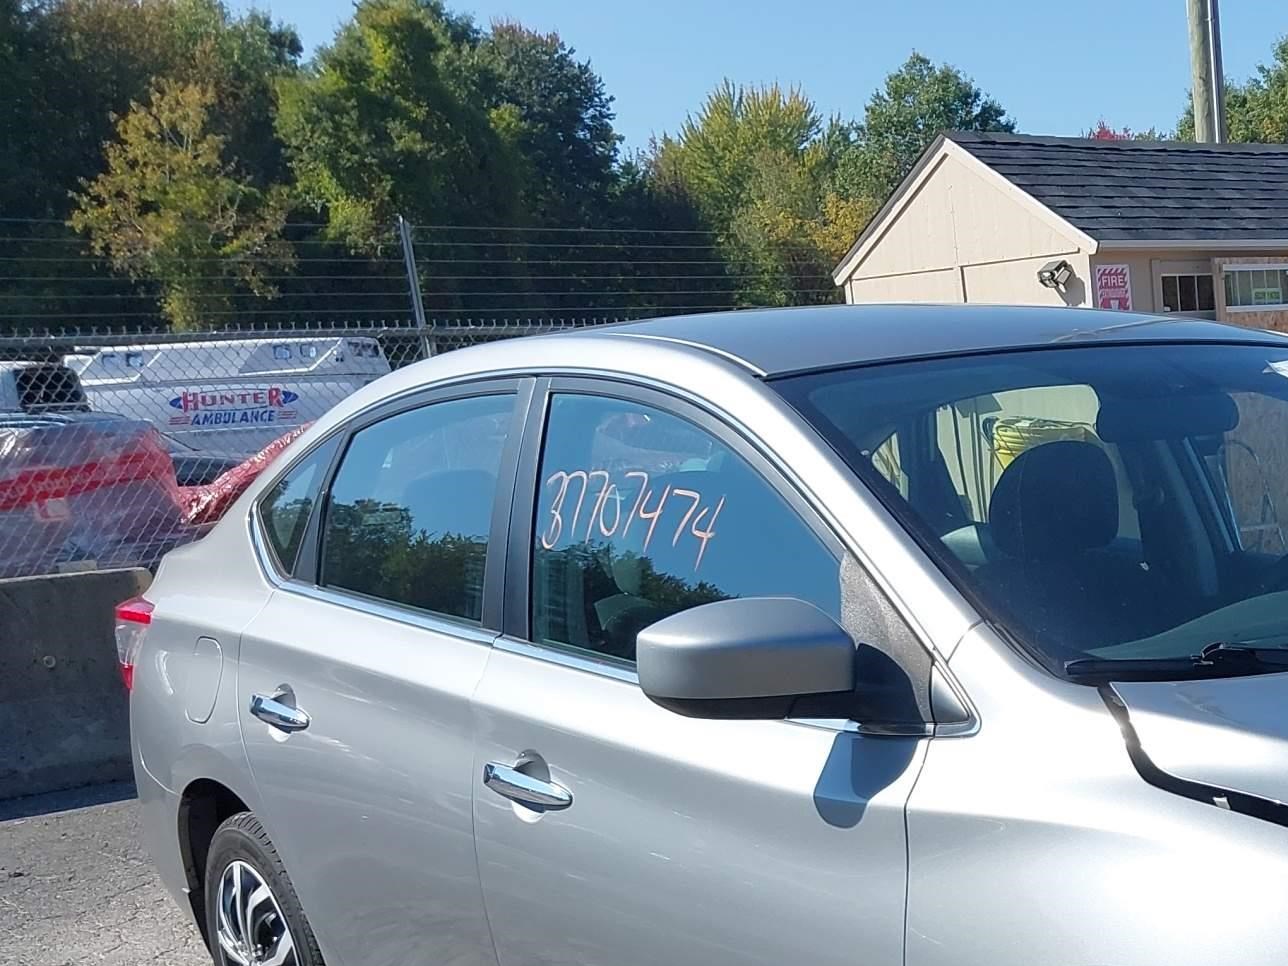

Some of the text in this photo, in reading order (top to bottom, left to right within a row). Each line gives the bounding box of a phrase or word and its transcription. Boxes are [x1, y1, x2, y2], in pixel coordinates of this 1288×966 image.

[1102, 275, 1126, 287] FIRE
[182, 387, 284, 413] HUNTER
[191, 410, 276, 426] AMBULANCE
[541, 470, 727, 573] 37707474
